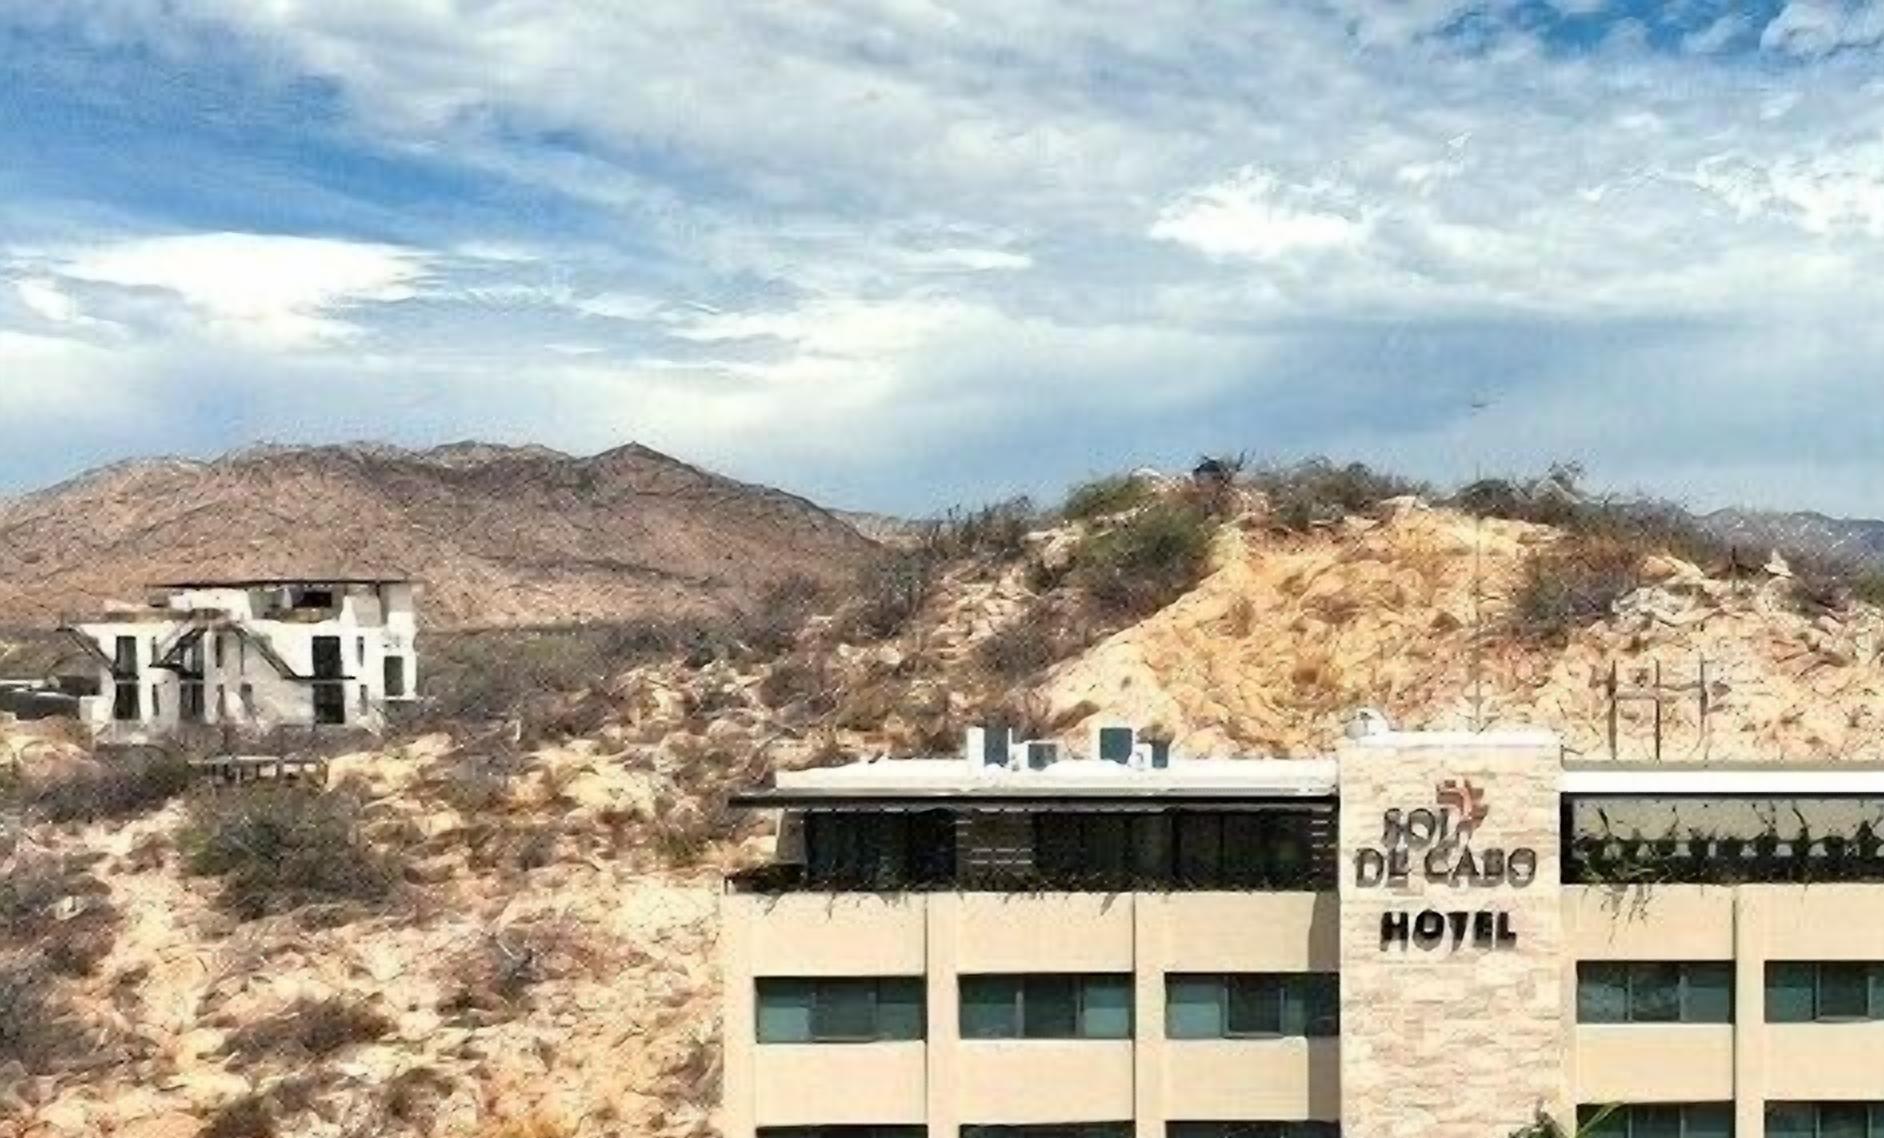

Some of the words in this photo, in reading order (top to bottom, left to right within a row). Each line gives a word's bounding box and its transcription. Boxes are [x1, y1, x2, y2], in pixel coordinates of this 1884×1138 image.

[1382, 806, 1449, 847] SOL
[1354, 848, 1410, 884] DE
[1424, 847, 1537, 885] CABO
[1380, 910, 1517, 947] HOTEL
